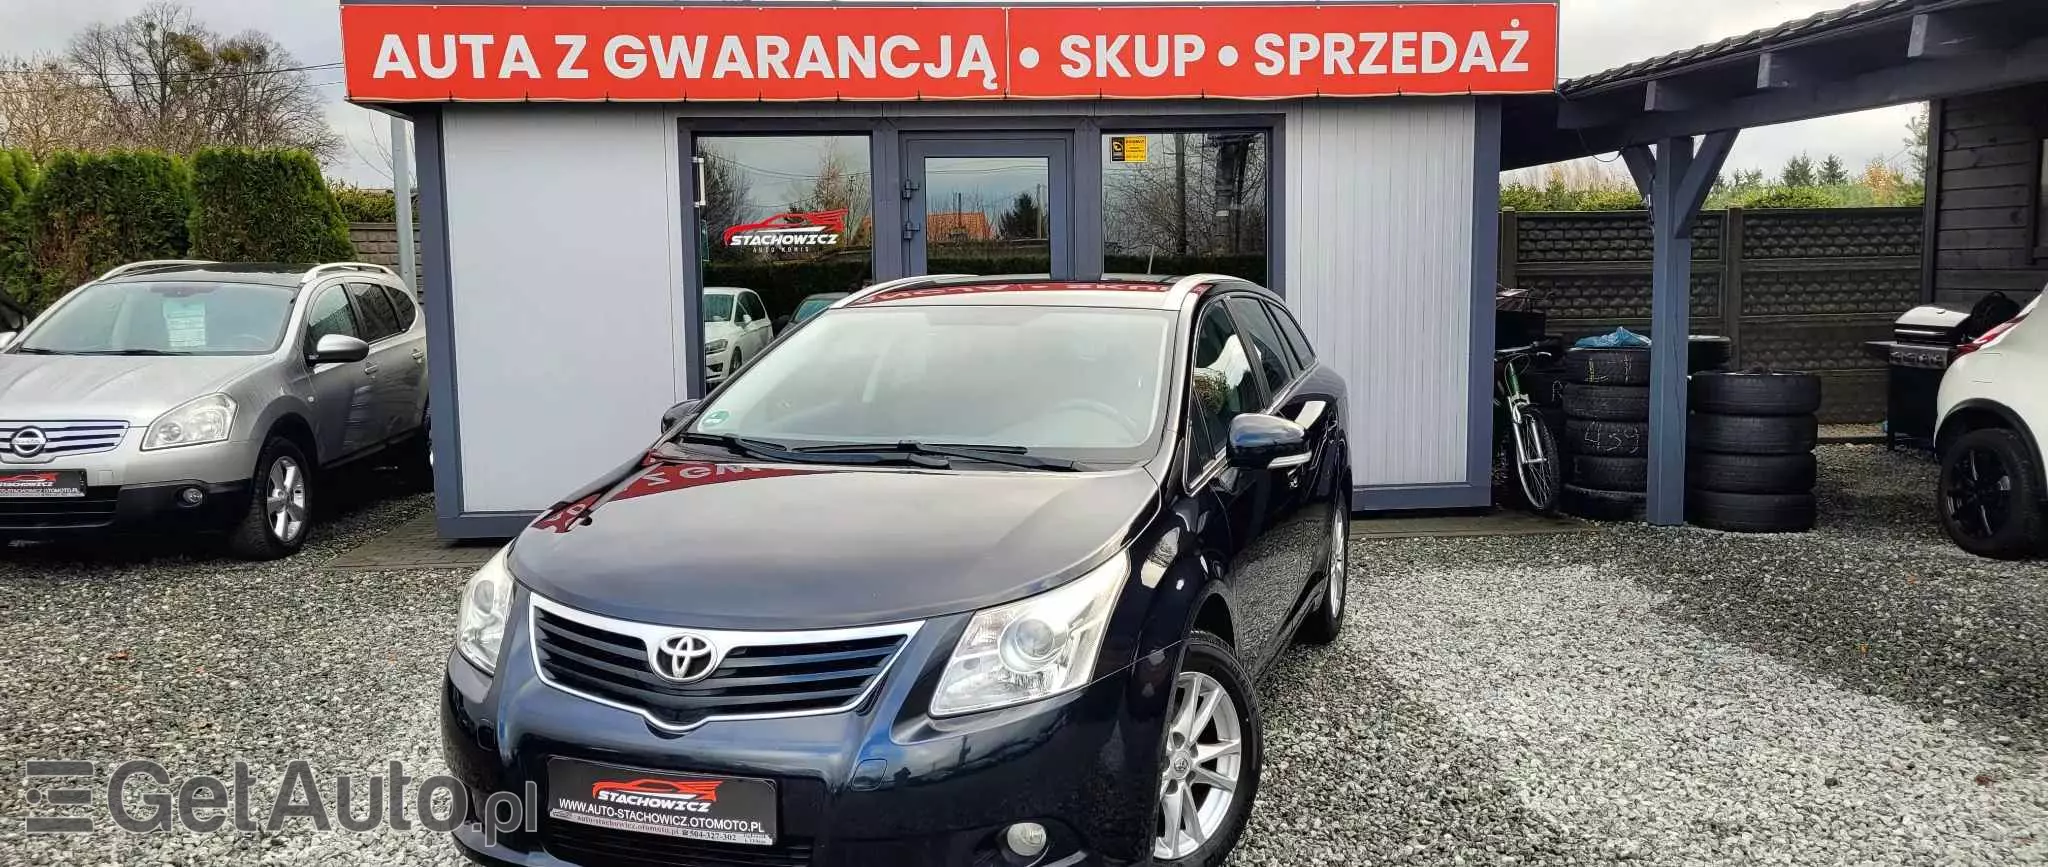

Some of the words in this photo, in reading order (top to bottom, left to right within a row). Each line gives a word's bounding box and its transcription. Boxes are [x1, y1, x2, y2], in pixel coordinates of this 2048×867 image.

[372, 34, 542, 79] AUTA
[557, 35, 589, 79] Z
[603, 34, 998, 90] GWARANCJĄ
[1059, 33, 1206, 79] SKUP
[1253, 18, 1530, 76] SPRZEDAŻ
[730, 233, 839, 246] STACHOWICZ
[558, 797, 766, 834] WWW.AUTO-STACHOWICZ.OTOMOTO.PL
[598, 790, 712, 813] STACHOWICZ
